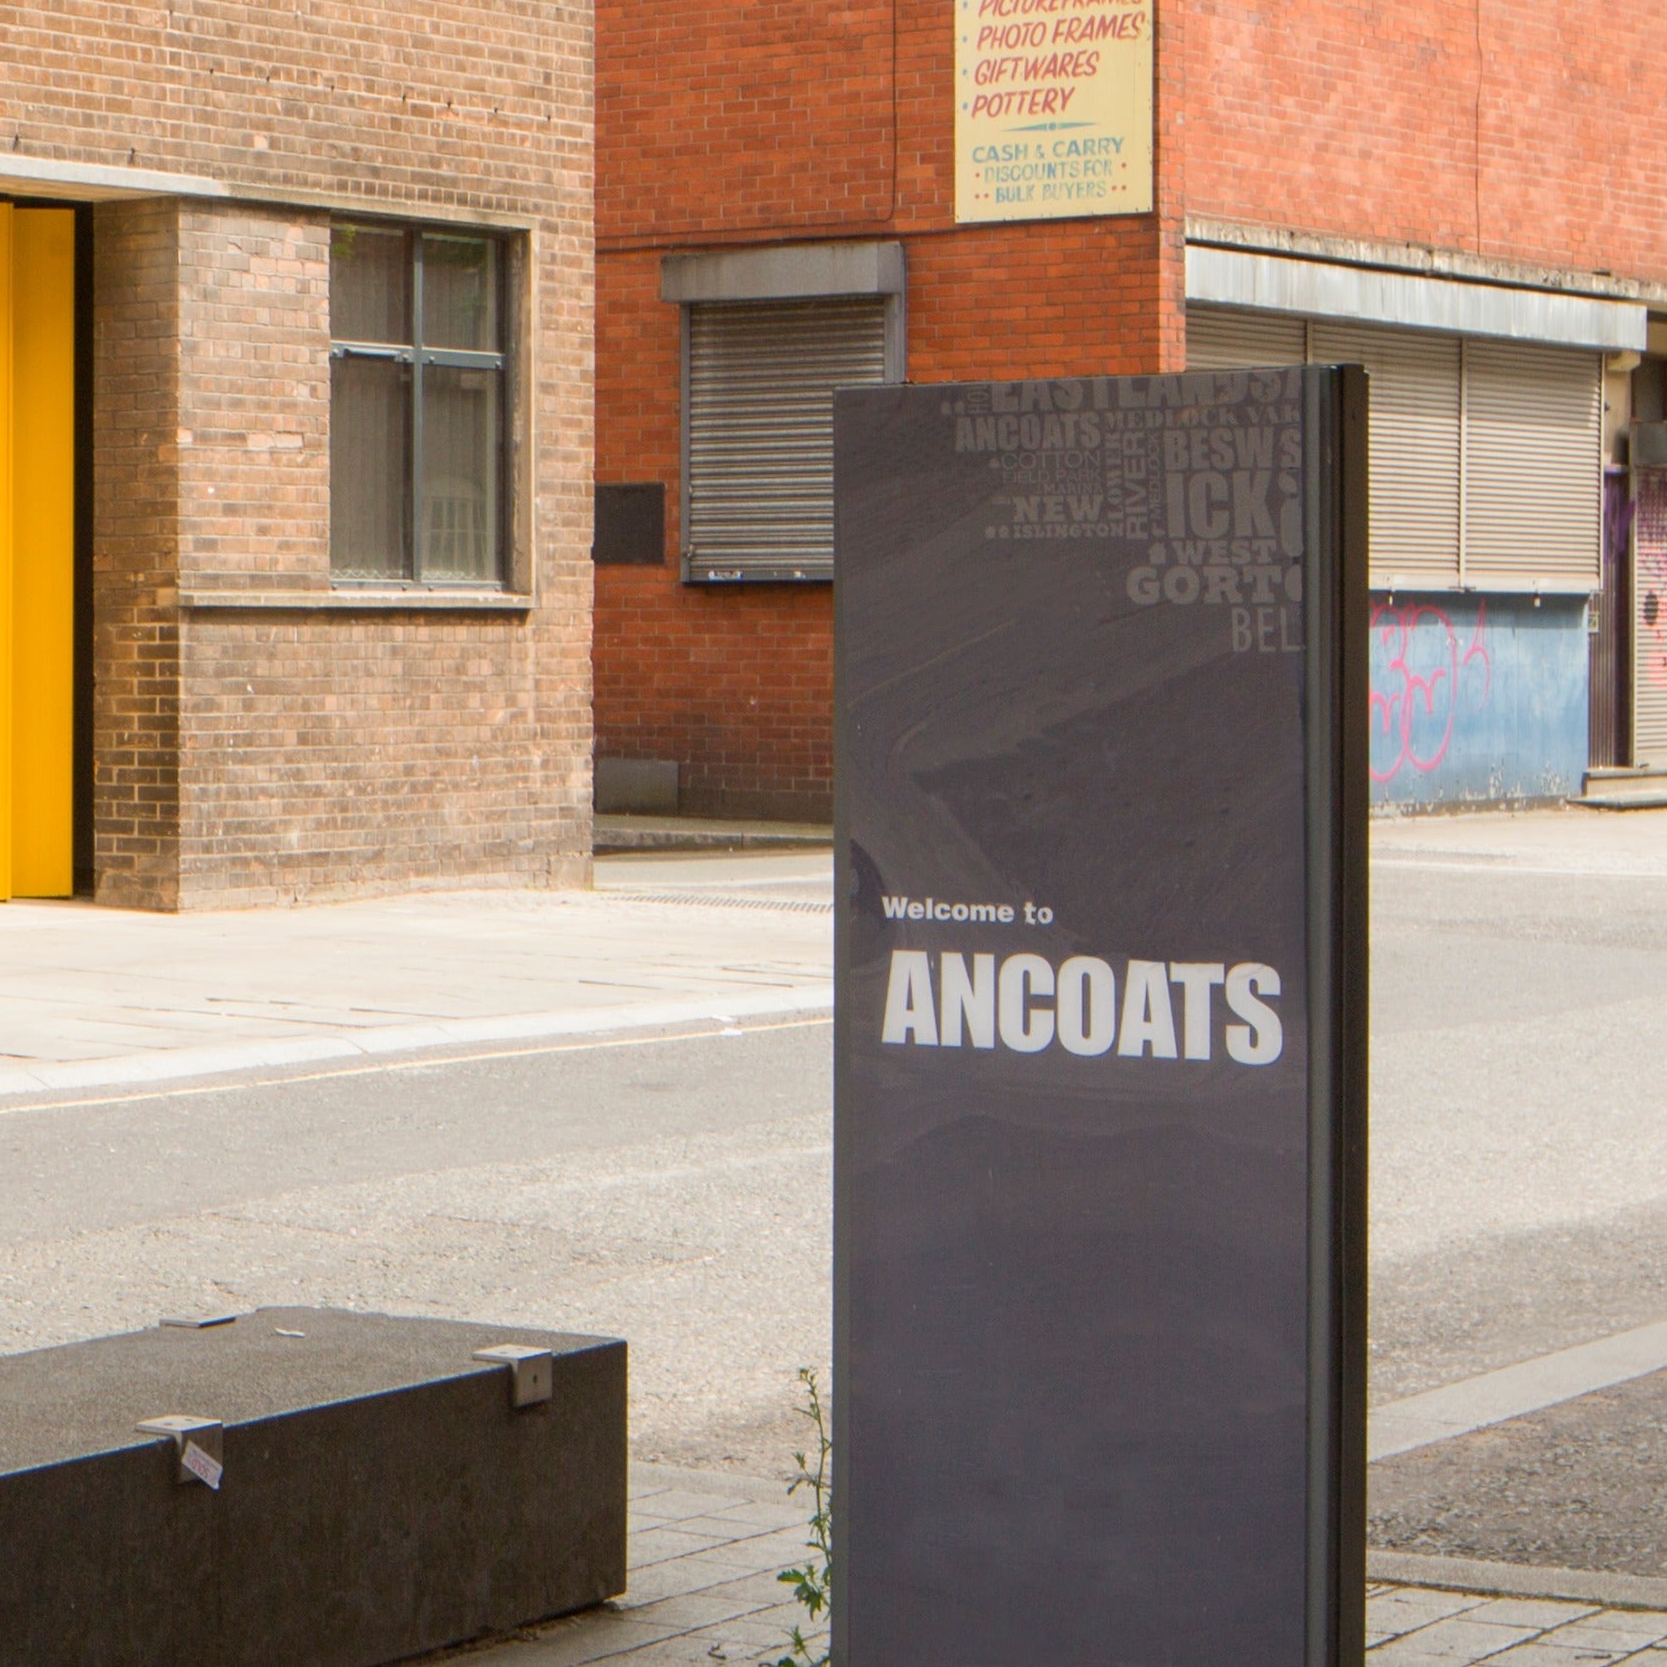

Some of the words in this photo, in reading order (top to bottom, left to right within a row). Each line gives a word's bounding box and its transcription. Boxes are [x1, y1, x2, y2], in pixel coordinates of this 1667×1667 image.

[977, 21, 1047, 51] PHOTO
[1051, 10, 1146, 46] FRAMES
[974, 50, 1100, 86] GIFTWARES
[971, 86, 1075, 120] POTTERY
[972, 141, 1029, 163] CASH
[1036, 143, 1046, 159] &
[1053, 136, 1125, 158] CARRY
[983, 161, 1080, 182] DISCOUNTS
[1083, 158, 1113, 177] FOR
[995, 184, 1036, 203] BULK
[1042, 180, 1108, 201] BUYERS
[955, 412, 1101, 453] ANCOATS
[1001, 450, 1101, 470] COTTON
[1164, 425, 1275, 471] BESW
[1002, 470, 1051, 484] FIELD
[1055, 468, 1102, 483] PARK
[1044, 483, 1103, 495] MARINA
[1123, 431, 1149, 539] RIVER
[1147, 431, 1162, 520] MEDLOCK
[1012, 494, 1104, 523] NEW
[1165, 468, 1277, 539] ICK
[1013, 523, 1125, 539] ISLINGTON
[1170, 539, 1277, 565] WEST
[881, 895, 1015, 924] Welcome
[1023, 901, 1054, 925] to
[881, 949, 1284, 1066] ANCOATS
